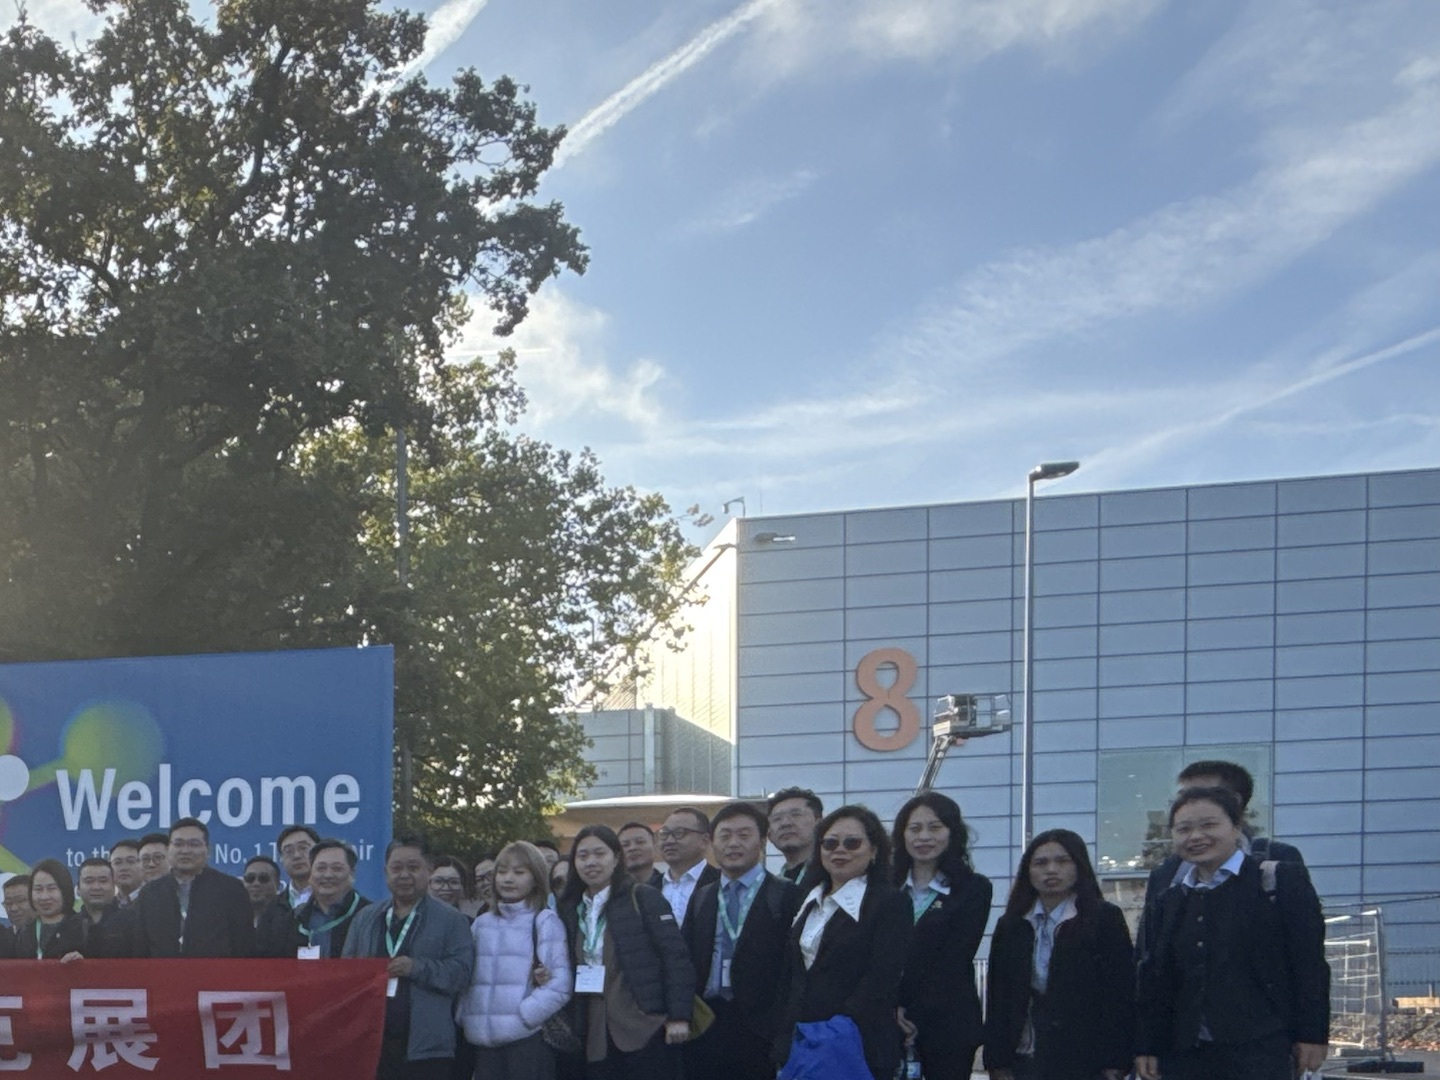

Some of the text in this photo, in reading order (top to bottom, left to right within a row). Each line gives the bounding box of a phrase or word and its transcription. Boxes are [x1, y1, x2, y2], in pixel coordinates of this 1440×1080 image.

[853, 646, 921, 752] 8
[56, 764, 360, 831] Welcome
[66, 847, 85, 867] to
[92, 845, 111, 859] th
[215, 843, 247, 864] No.
